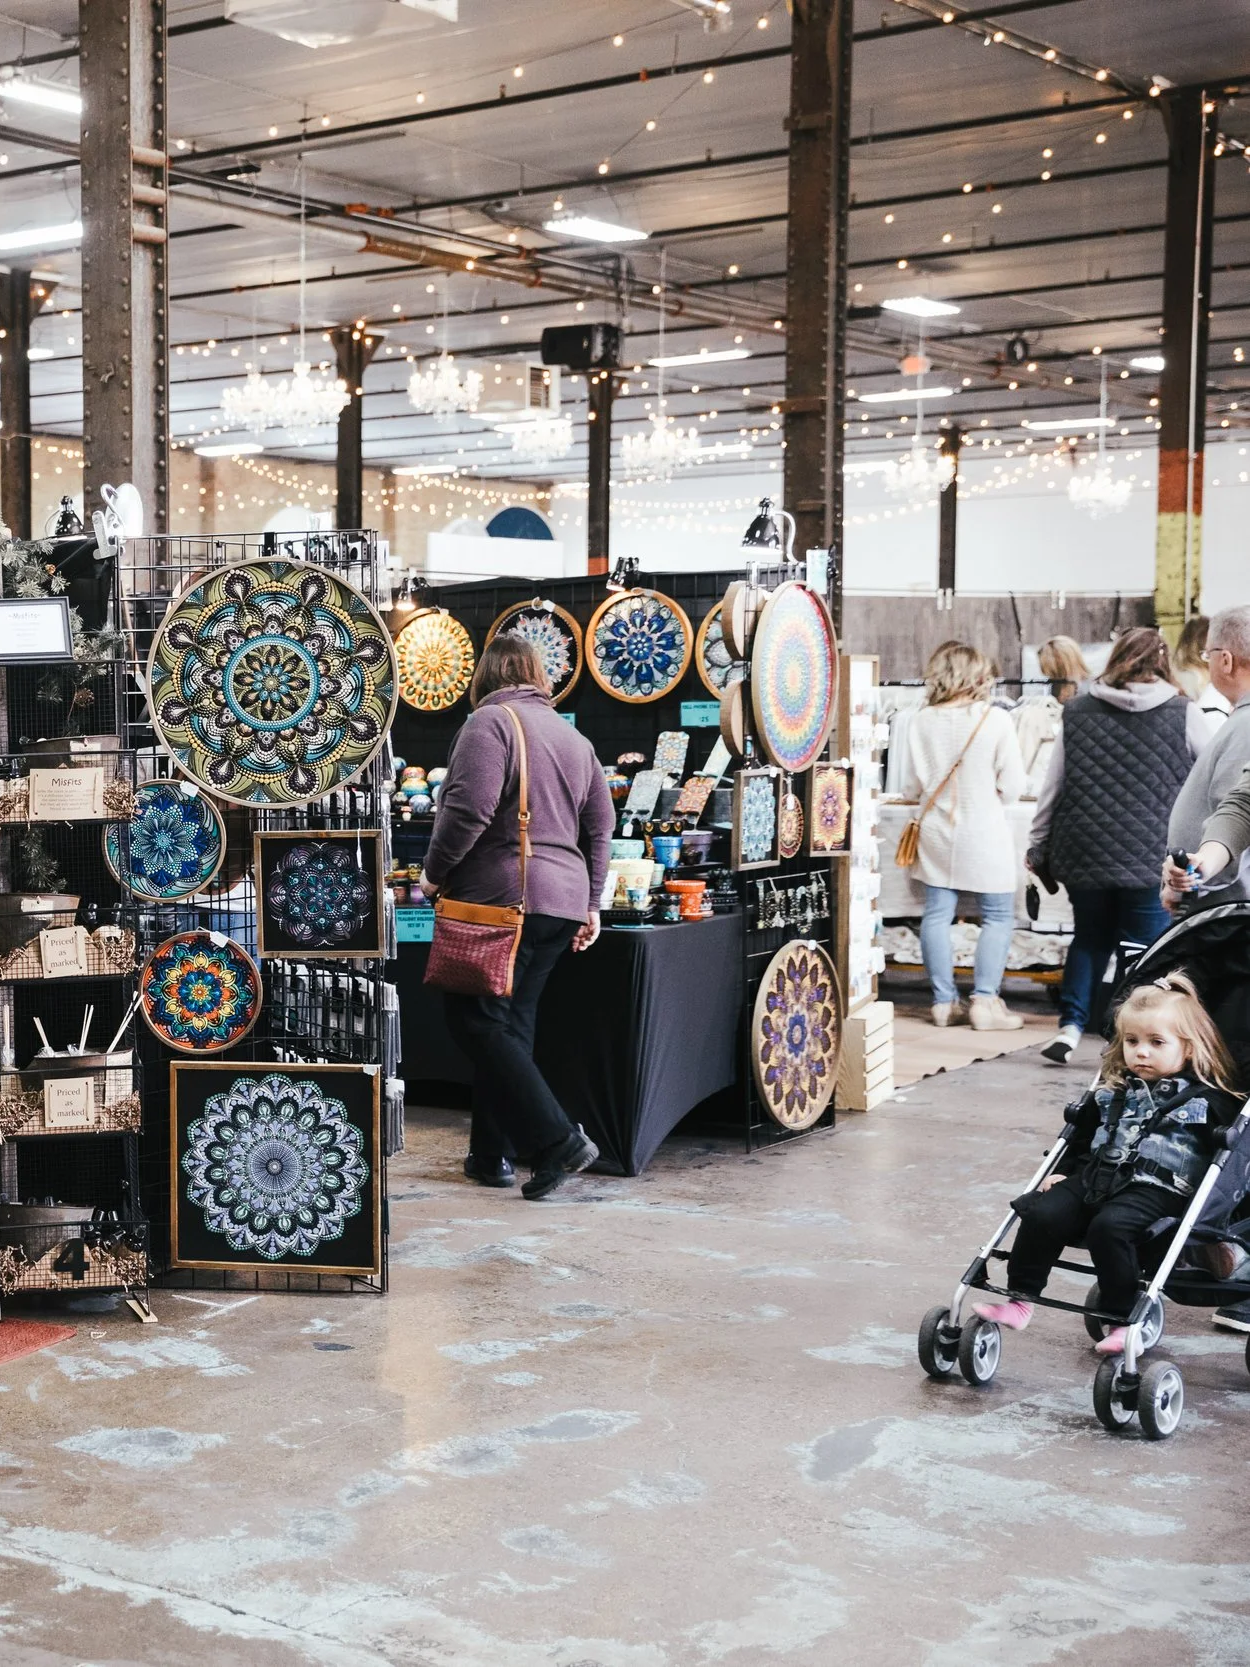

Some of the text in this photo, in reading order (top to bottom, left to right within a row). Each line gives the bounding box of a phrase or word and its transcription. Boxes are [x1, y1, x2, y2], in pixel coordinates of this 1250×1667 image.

[51, 777, 83, 787] Misfits
[50, 937, 74, 947] Priced
[50, 957, 78, 968] marked
[56, 1088, 81, 1097] Priced
[56, 1108, 85, 1117] marked
[53, 1238, 90, 1280] 4
